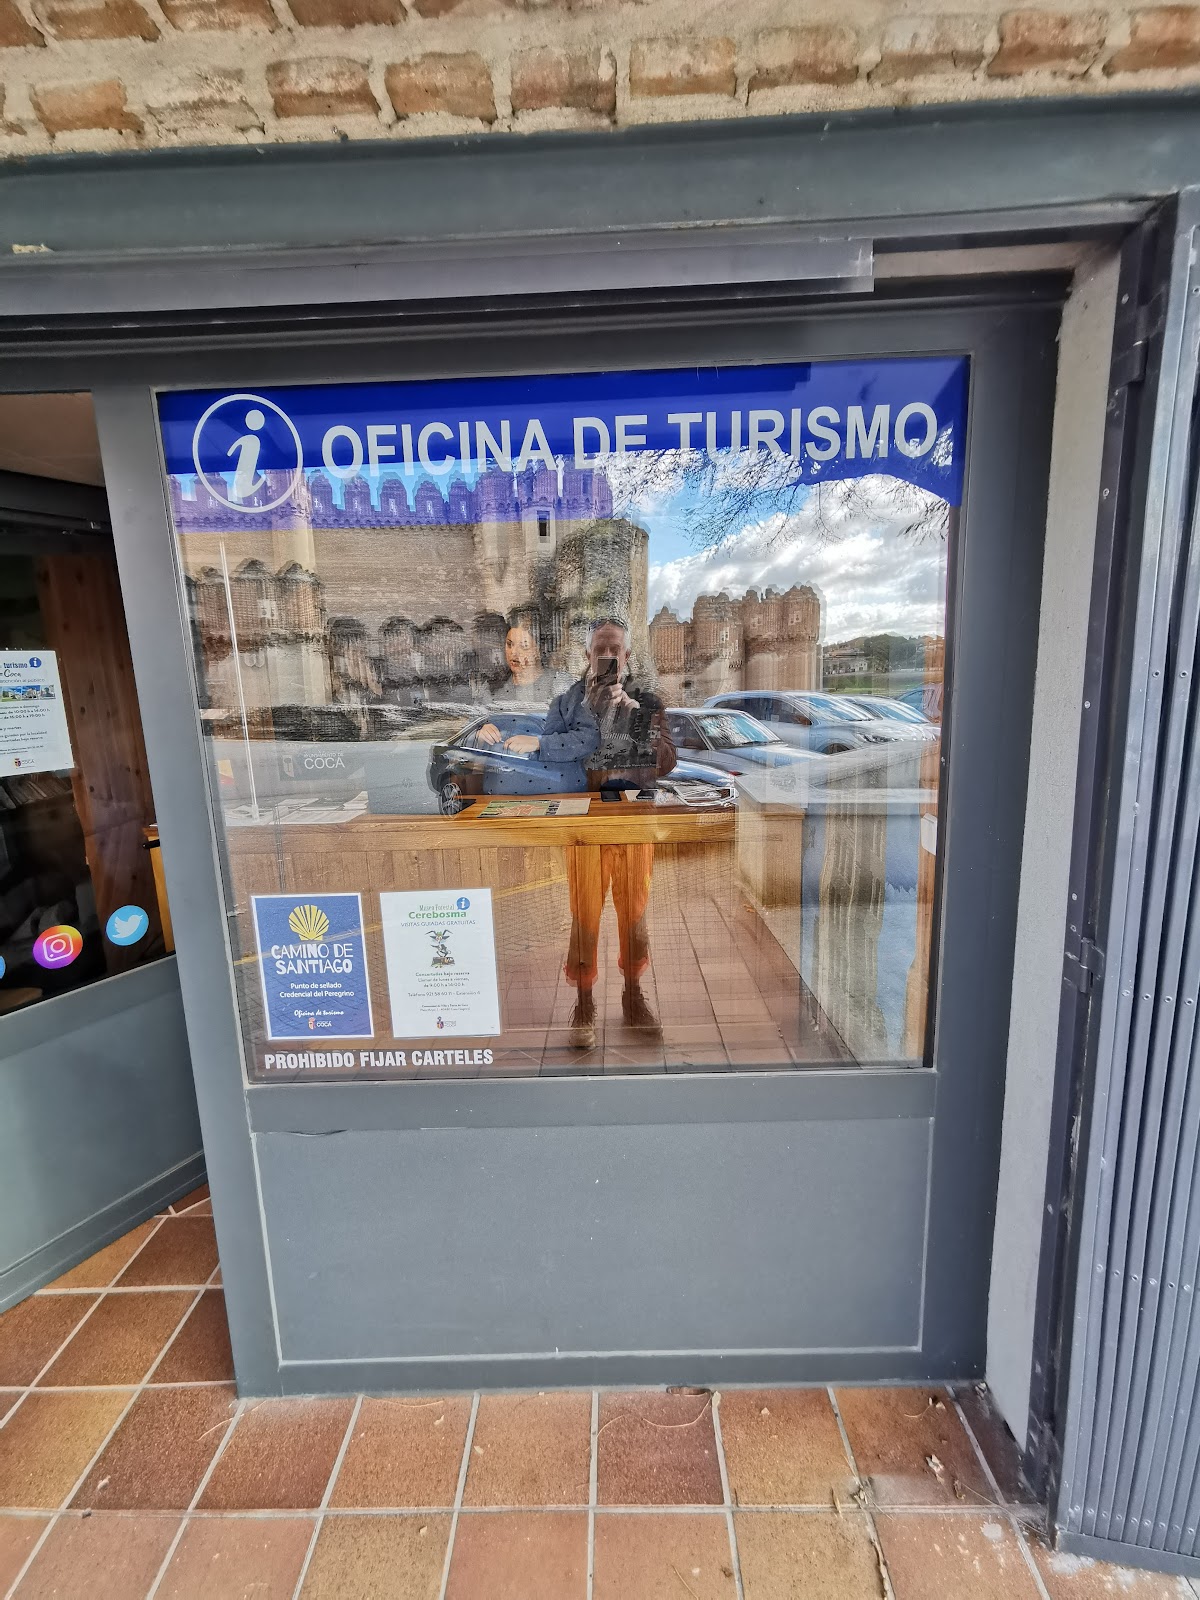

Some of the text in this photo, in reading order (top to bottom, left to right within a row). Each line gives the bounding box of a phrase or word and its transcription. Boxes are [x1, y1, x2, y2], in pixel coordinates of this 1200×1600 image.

[321, 401, 938, 478] OFICINA DE TURISMO
[304, 757, 345, 769] COCA
[408, 911, 467, 919] Cerebosma
[271, 943, 354, 960] CAMINO DE
[275, 959, 353, 975] SANTIAGO
[294, 1009, 315, 1018] Oficina
[264, 1048, 494, 1069] PROHIBIDO FIJAR CARTELES
